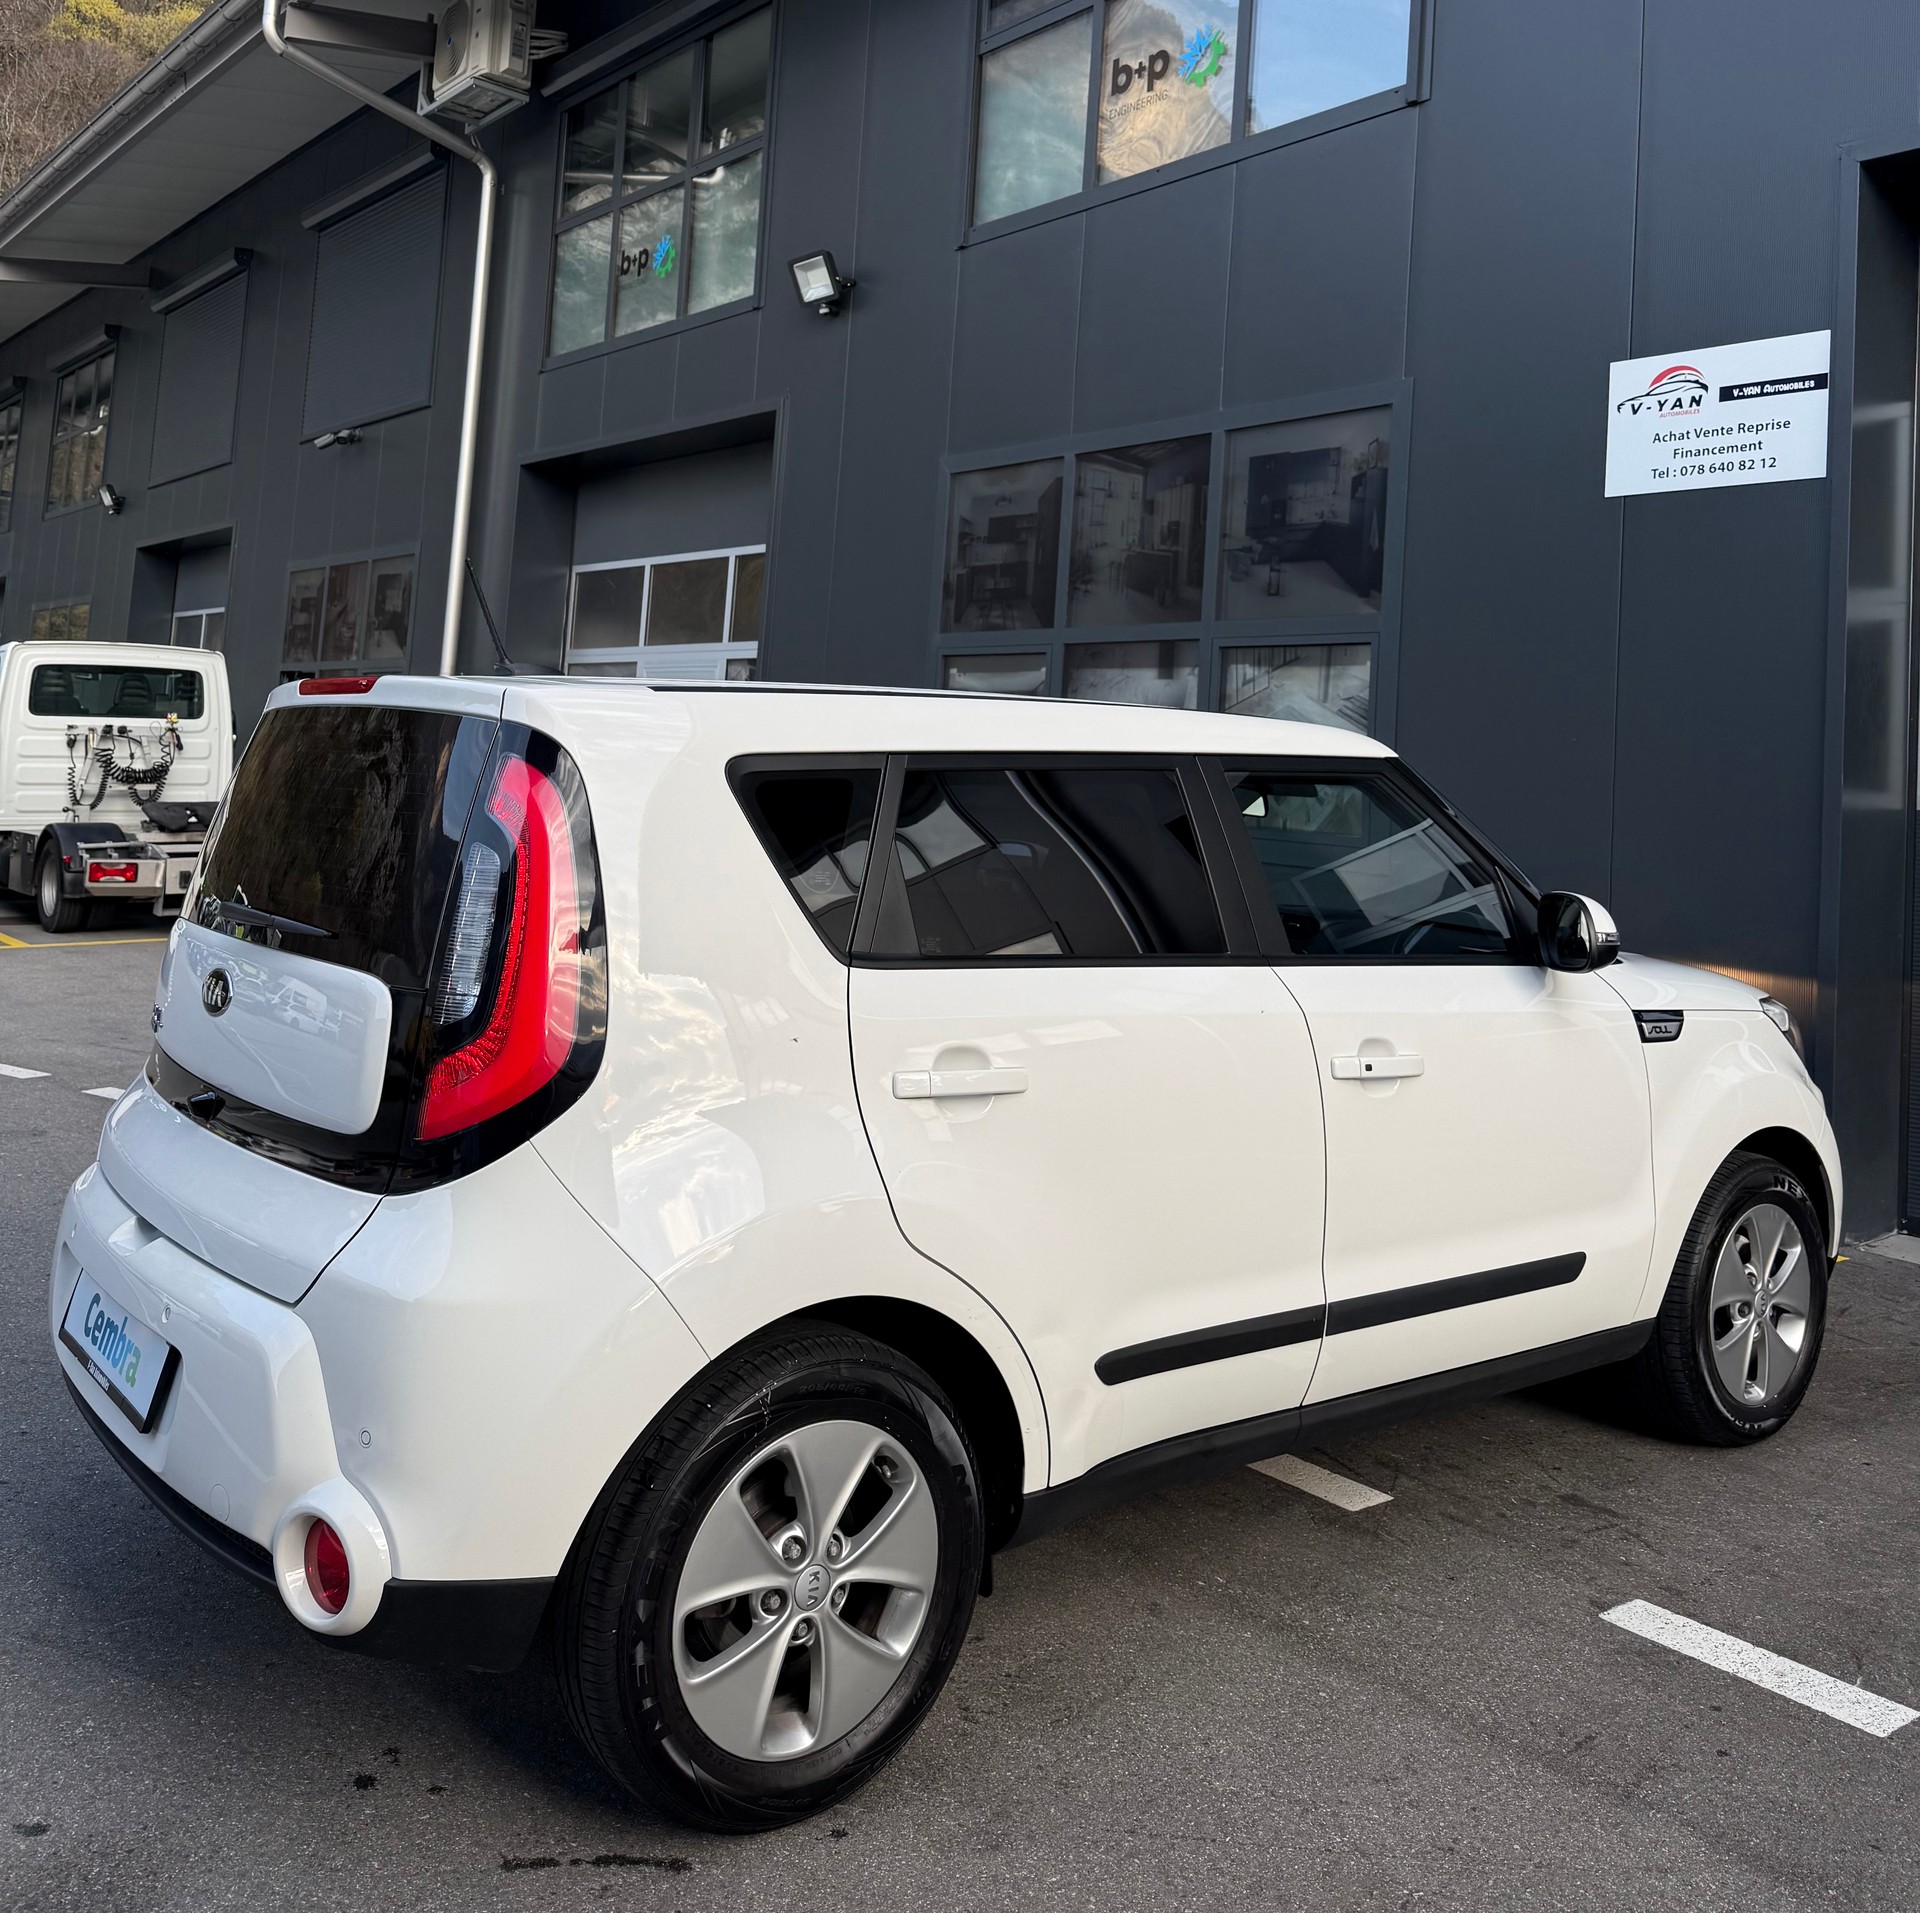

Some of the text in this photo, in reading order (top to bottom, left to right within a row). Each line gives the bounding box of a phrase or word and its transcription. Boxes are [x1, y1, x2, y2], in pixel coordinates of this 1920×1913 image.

[1110, 49, 1170, 96] b+p
[1108, 90, 1169, 120] ENGINEERING
[620, 248, 649, 277] b+p
[1733, 385, 1761, 397] V-YAN
[1659, 408, 1700, 418] AUTOMOBILES
[1652, 419, 1791, 444] Achat Vente Reprise
[1673, 440, 1763, 459] Financement
[1680, 464, 1705, 477] 078
[1708, 461, 1734, 474] 640
[1738, 459, 1756, 471] 82
[1760, 456, 1777, 469] 12
[84, 1292, 142, 1389] Cembra
[806, 1571, 821, 1607] KIA
